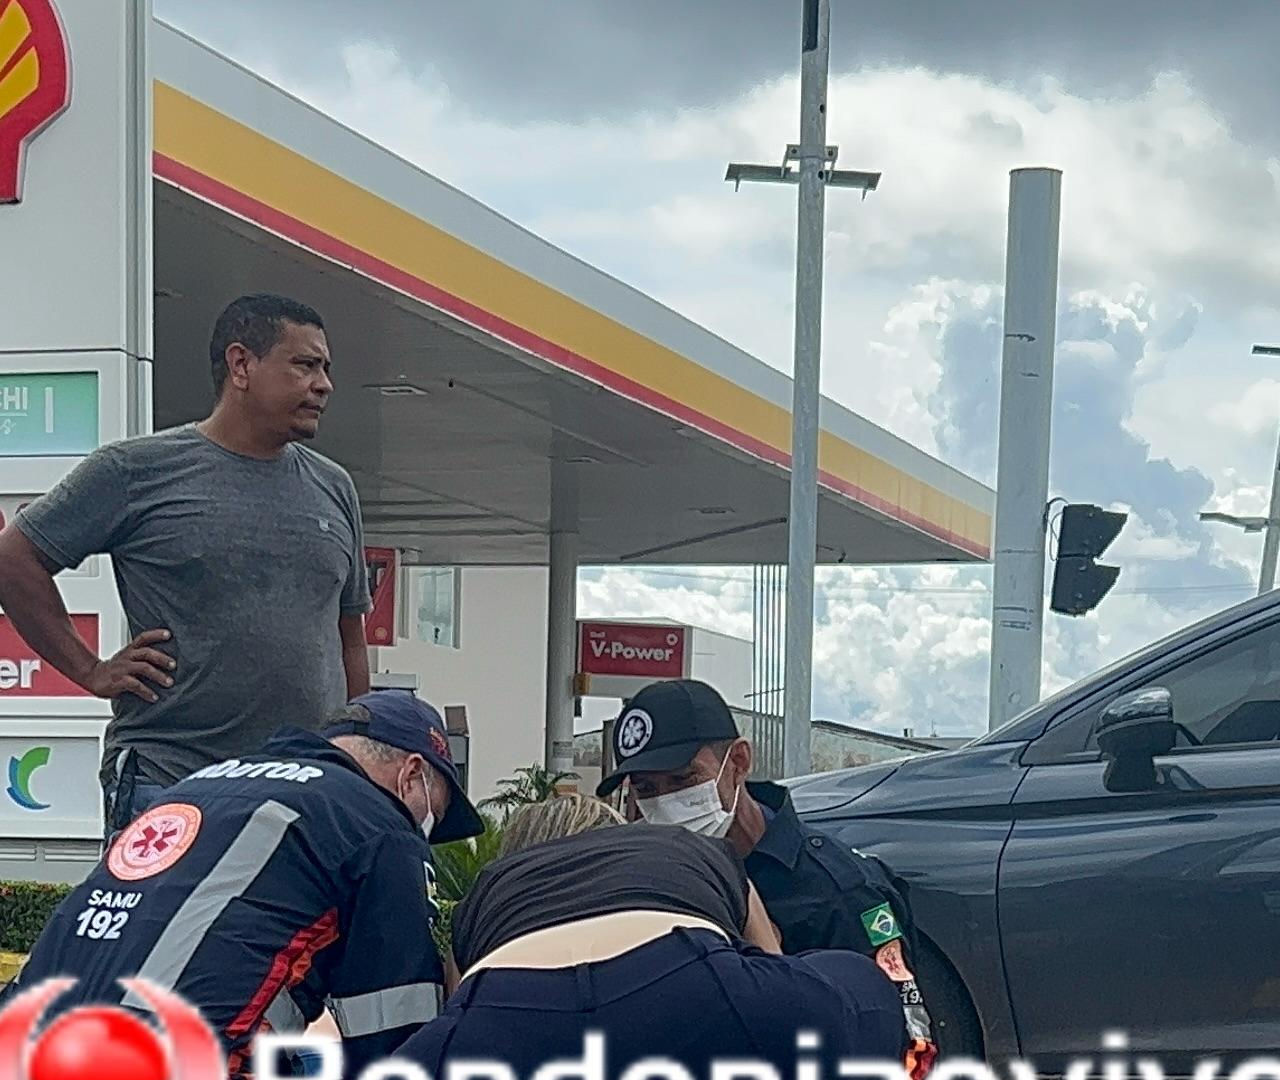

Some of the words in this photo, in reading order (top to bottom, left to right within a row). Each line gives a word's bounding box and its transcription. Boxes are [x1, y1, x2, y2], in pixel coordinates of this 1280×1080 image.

[589, 639, 675, 661] V-Power
[88, 889, 143, 910] SAMU
[76, 908, 129, 941] 192
